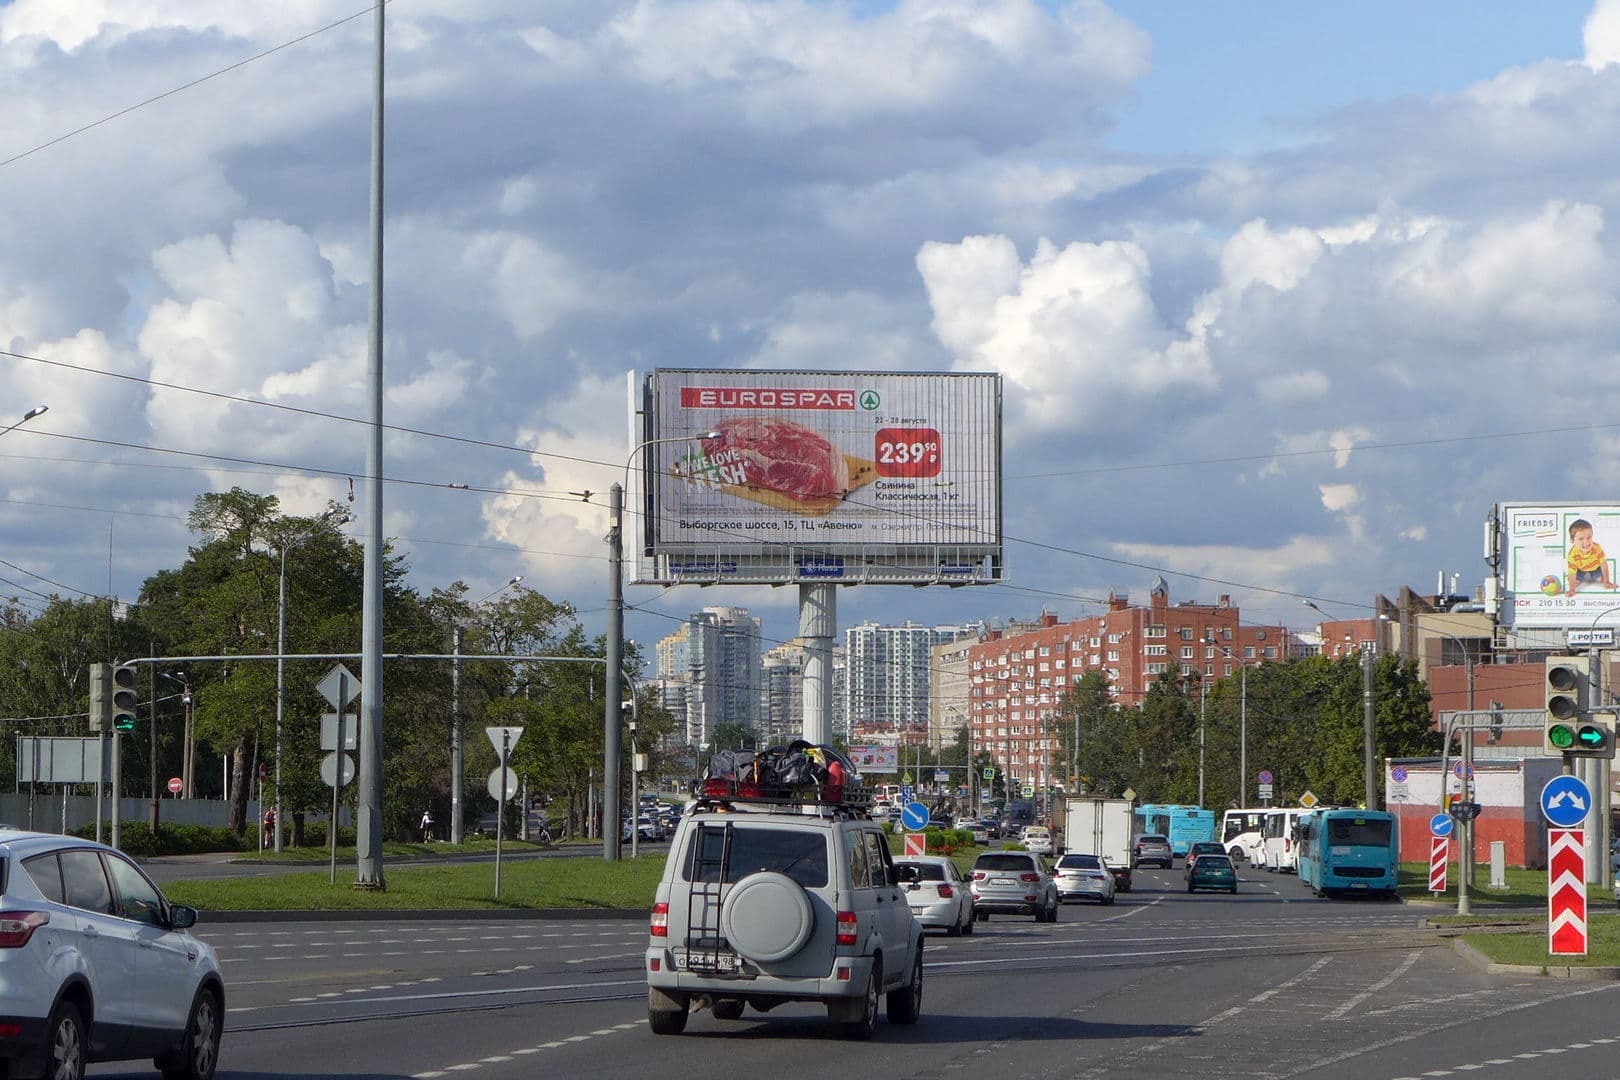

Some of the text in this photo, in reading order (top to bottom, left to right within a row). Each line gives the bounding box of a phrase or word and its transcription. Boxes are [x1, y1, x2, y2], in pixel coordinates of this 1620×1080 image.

[699, 391, 855, 407] EUROSPAR
[710, 448, 740, 467] LOVE
[880, 442, 924, 464] 239
[875, 480, 915, 490] Свинина
[680, 519, 863, 532] Выборгское шоссе, 15, ТЦ «Авеню»
[1517, 519, 1554, 527] FRIENDS
[1538, 599, 1553, 607] 210
[1555, 599, 1563, 607] 15
[1565, 599, 1577, 607] 30
[722, 956, 735, 966] 98
